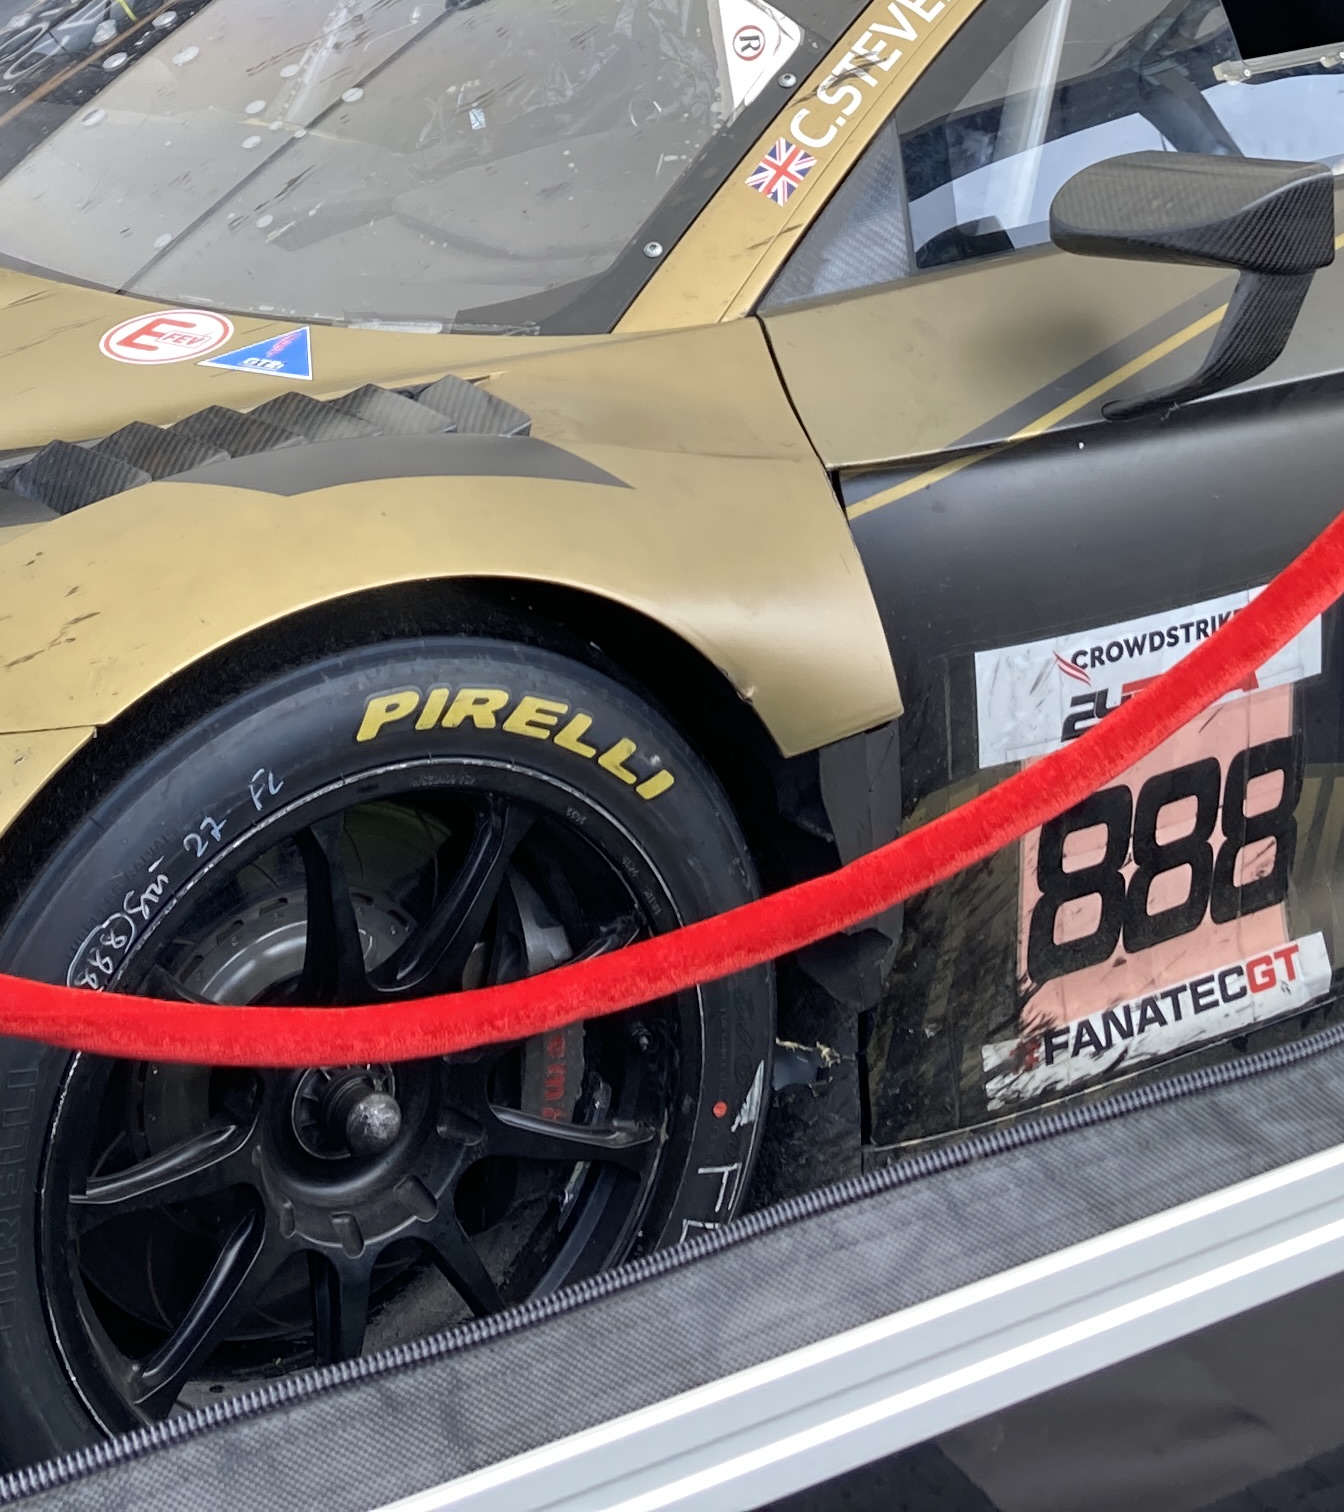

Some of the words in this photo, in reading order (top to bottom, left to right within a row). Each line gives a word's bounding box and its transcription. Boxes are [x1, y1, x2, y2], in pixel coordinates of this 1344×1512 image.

[116, 317, 197, 352] E
[163, 331, 206, 346] FEV
[356, 686, 676, 801] PIRELLI
[1027, 734, 1305, 985] 888
